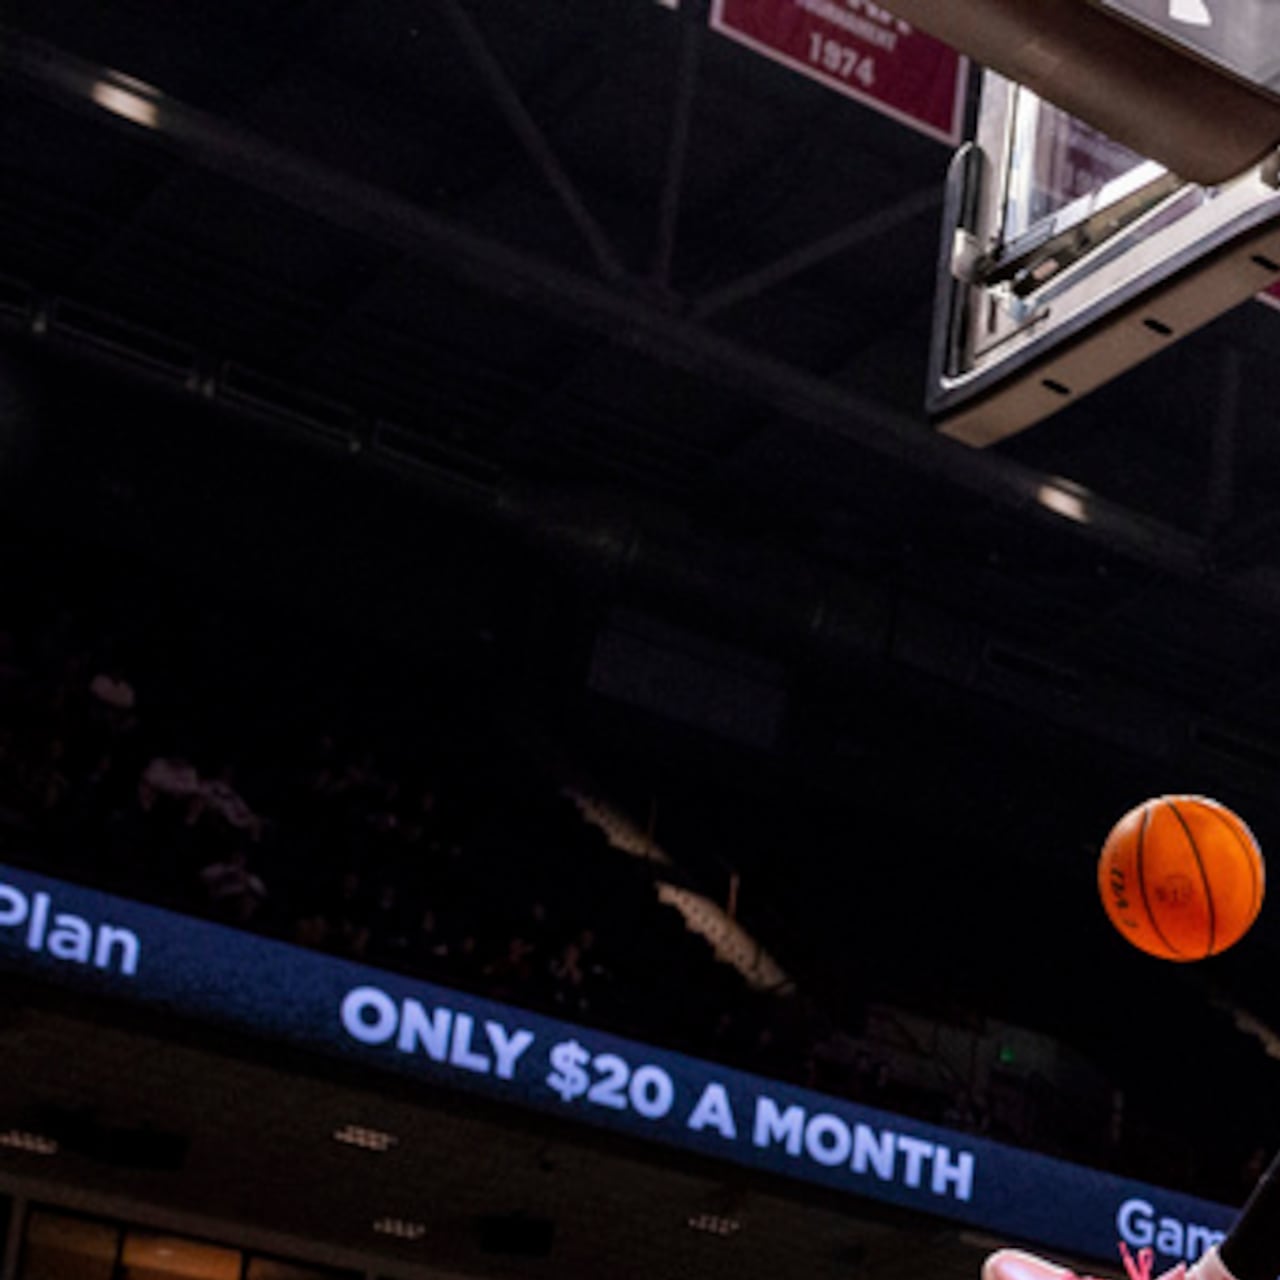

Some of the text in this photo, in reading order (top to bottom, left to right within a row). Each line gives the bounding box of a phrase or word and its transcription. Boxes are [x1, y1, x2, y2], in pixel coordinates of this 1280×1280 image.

[808, 32, 876, 87] 1974
[340, 986, 975, 1202] ONLY $20 A MONTH
